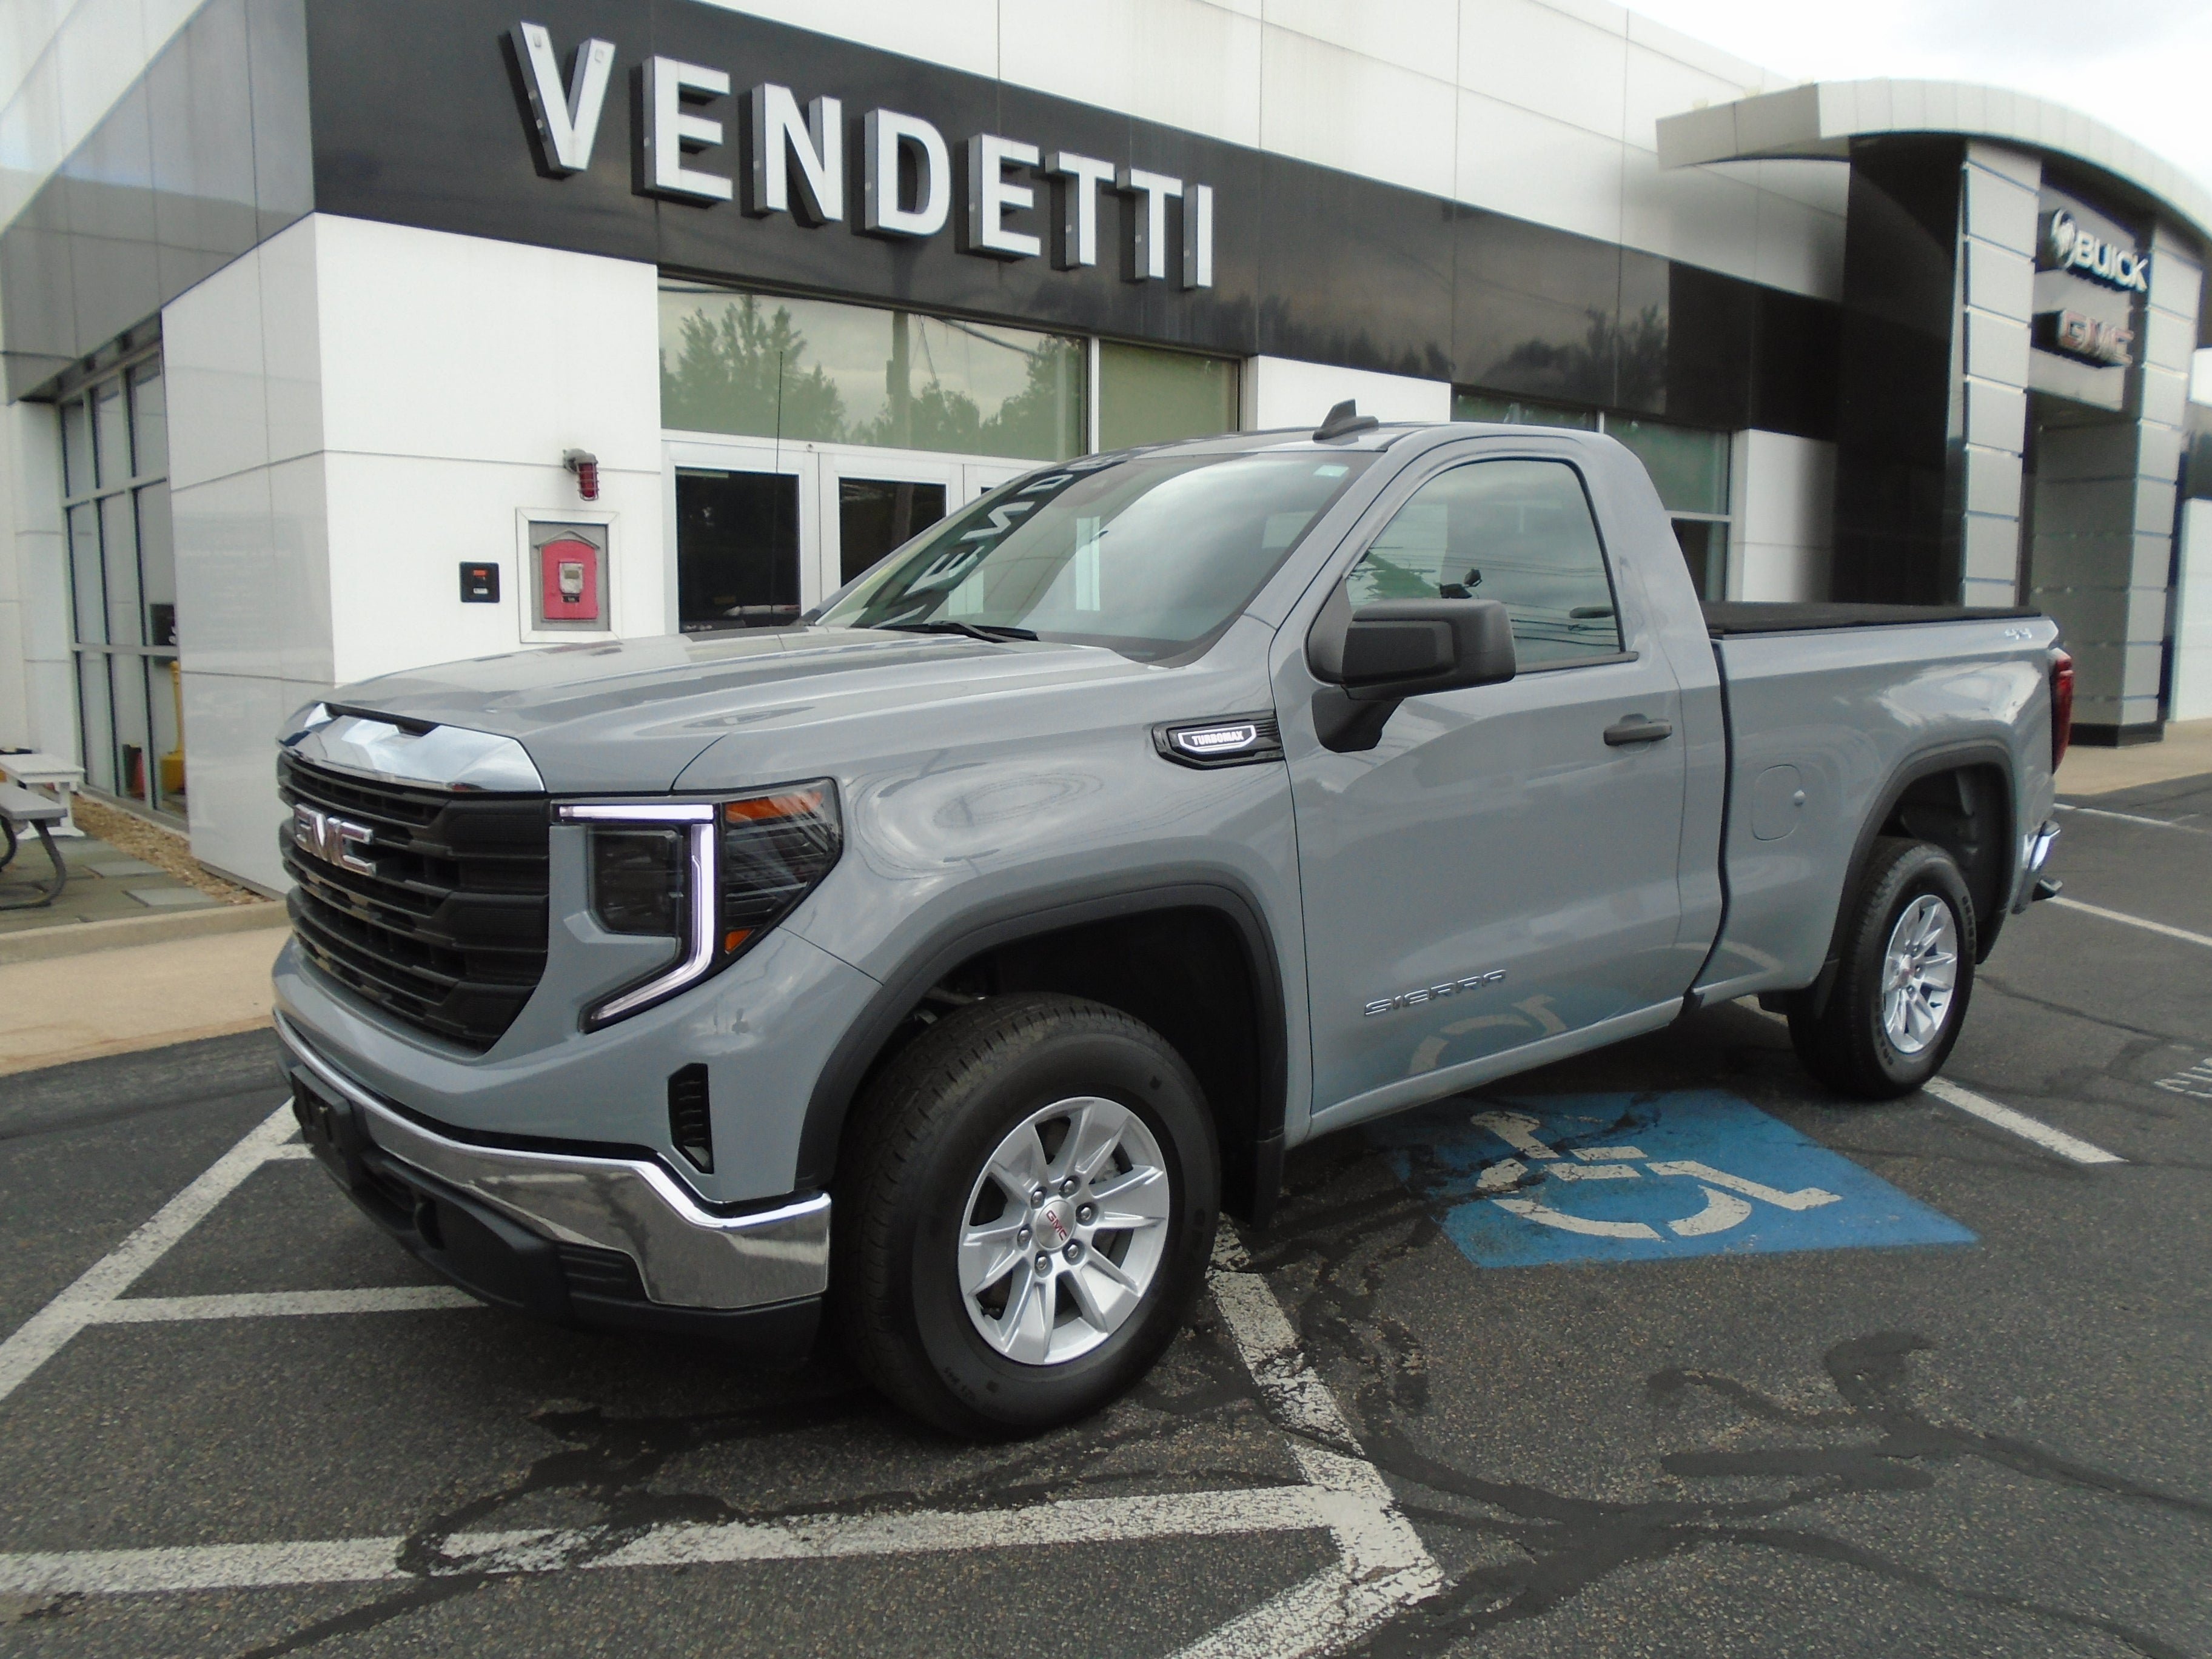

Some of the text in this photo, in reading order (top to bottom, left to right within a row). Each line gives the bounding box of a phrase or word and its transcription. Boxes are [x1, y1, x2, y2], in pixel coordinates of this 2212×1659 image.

[514, 21, 1213, 288] VENDETTI
[2076, 230, 2149, 292] BUICK
[2058, 309, 2134, 367] GMC
[1191, 730, 1244, 746] TURBOMAX
[294, 803, 377, 877] GMC
[1364, 969, 1507, 1016] SIERRA
[1045, 1210, 1067, 1241] GMC
